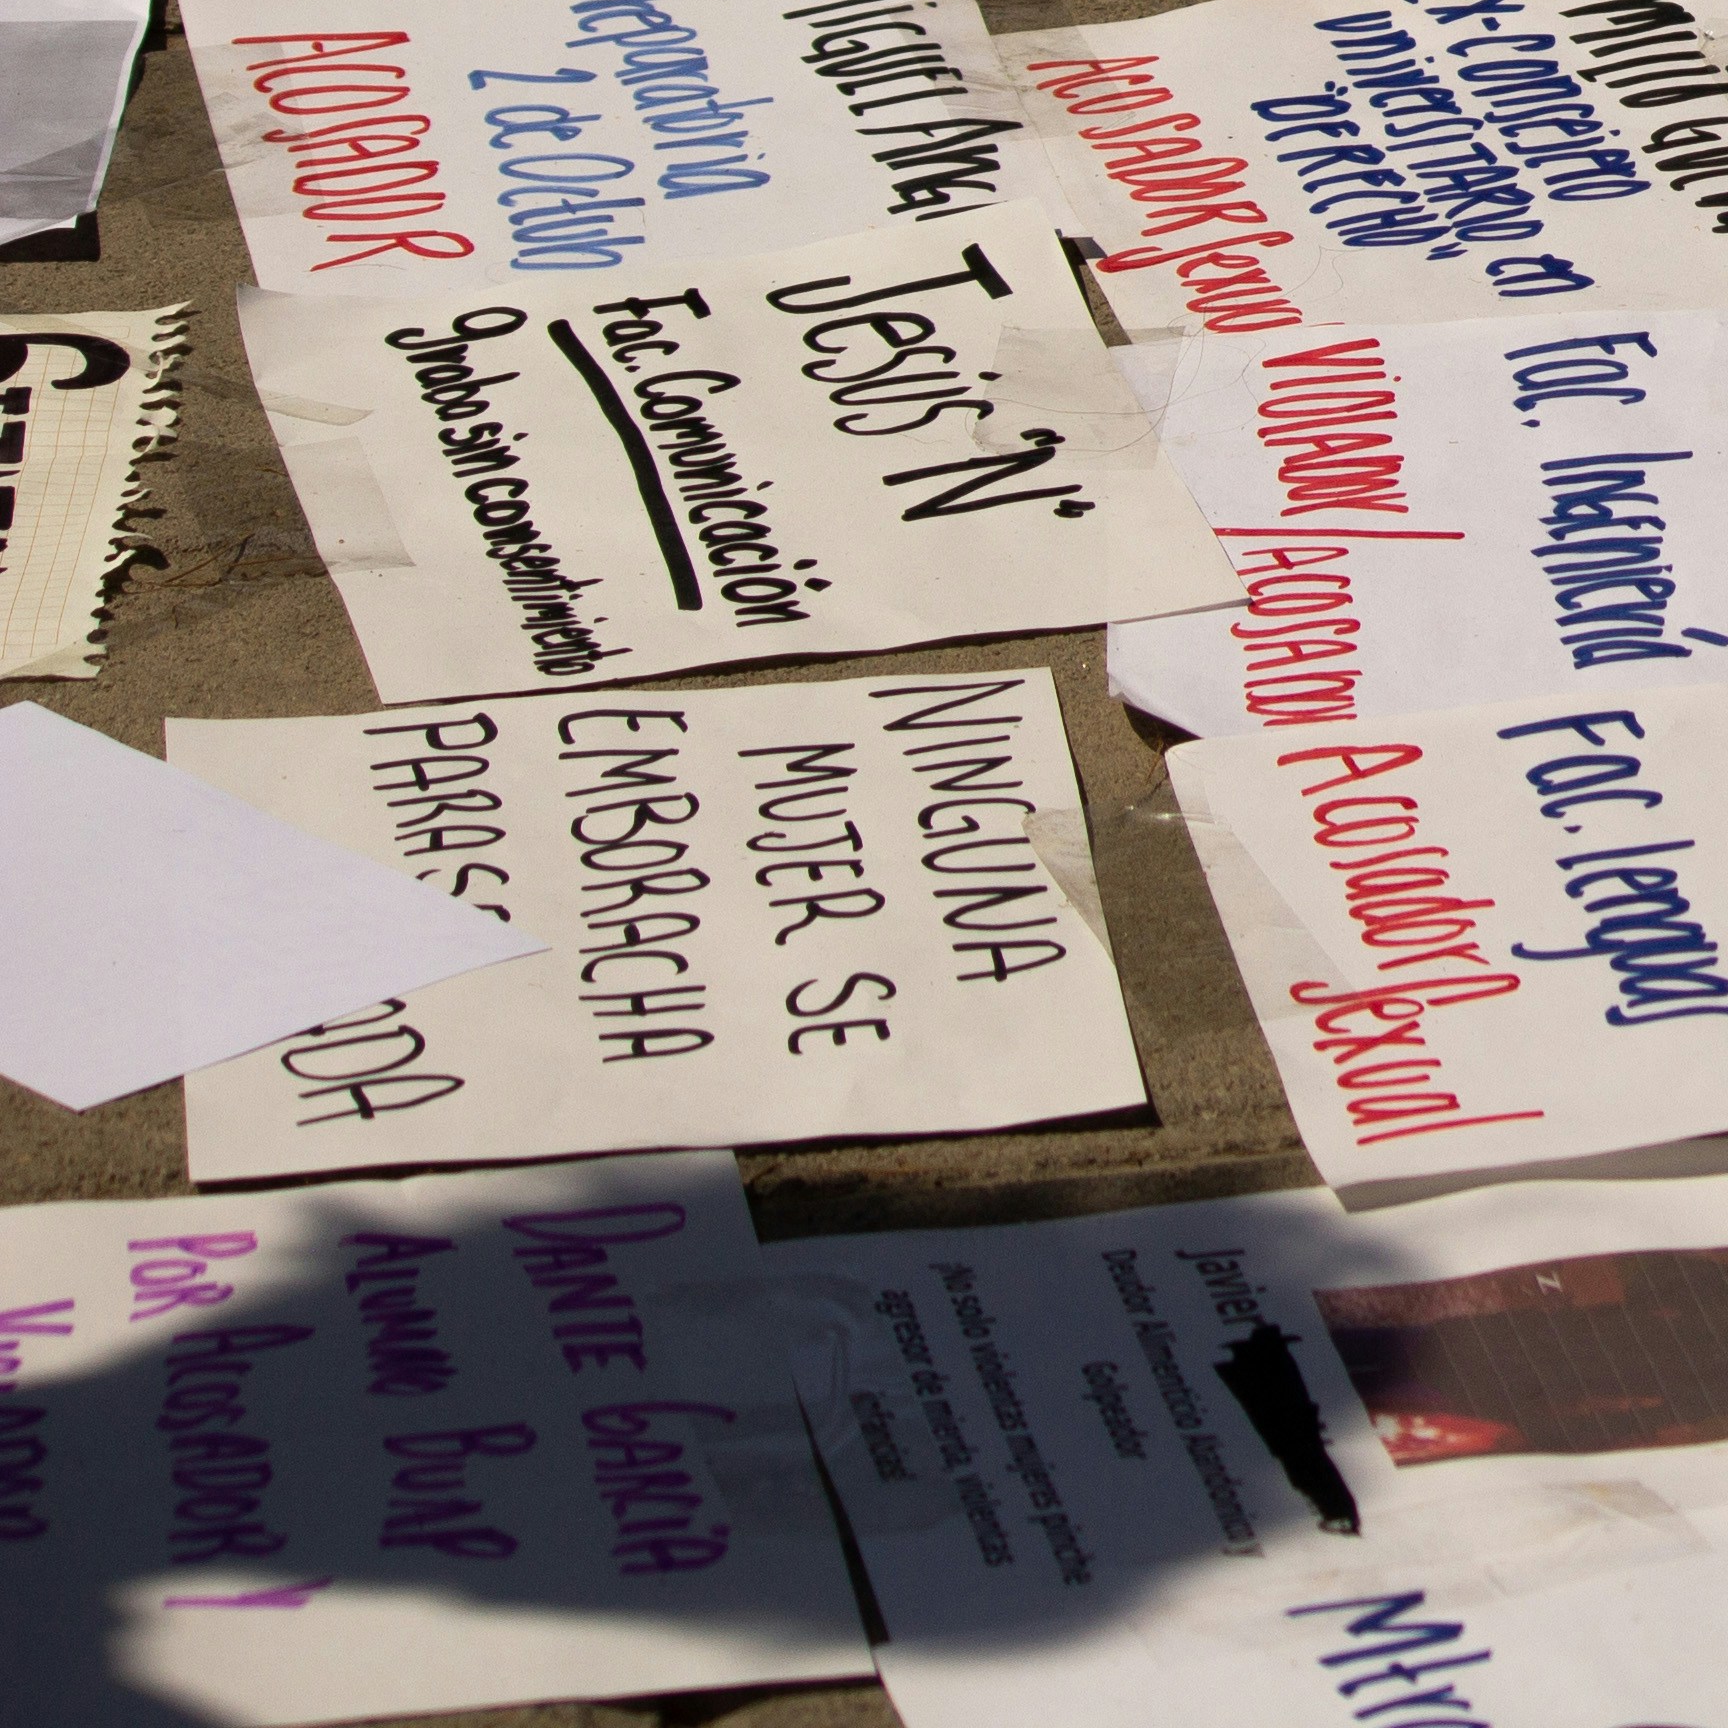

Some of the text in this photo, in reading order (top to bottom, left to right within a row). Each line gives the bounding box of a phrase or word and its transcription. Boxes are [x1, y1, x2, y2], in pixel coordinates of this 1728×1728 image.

[233, 31, 473, 271] ACOSADOR
[486, 104, 602, 148] de
[385, 307, 528, 421] graba
[441, 423, 529, 477] sin
[632, 370, 831, 627] Comunicación
[559, 710, 714, 1063] EMBORACHA
[738, 743, 896, 1055] MUJER SE
[869, 679, 1066, 982] NINGUNA
[1276, 744, 1496, 970] Acosador
[127, 1231, 259, 1322] POR
[1175, 1247, 1267, 1325] Javier
